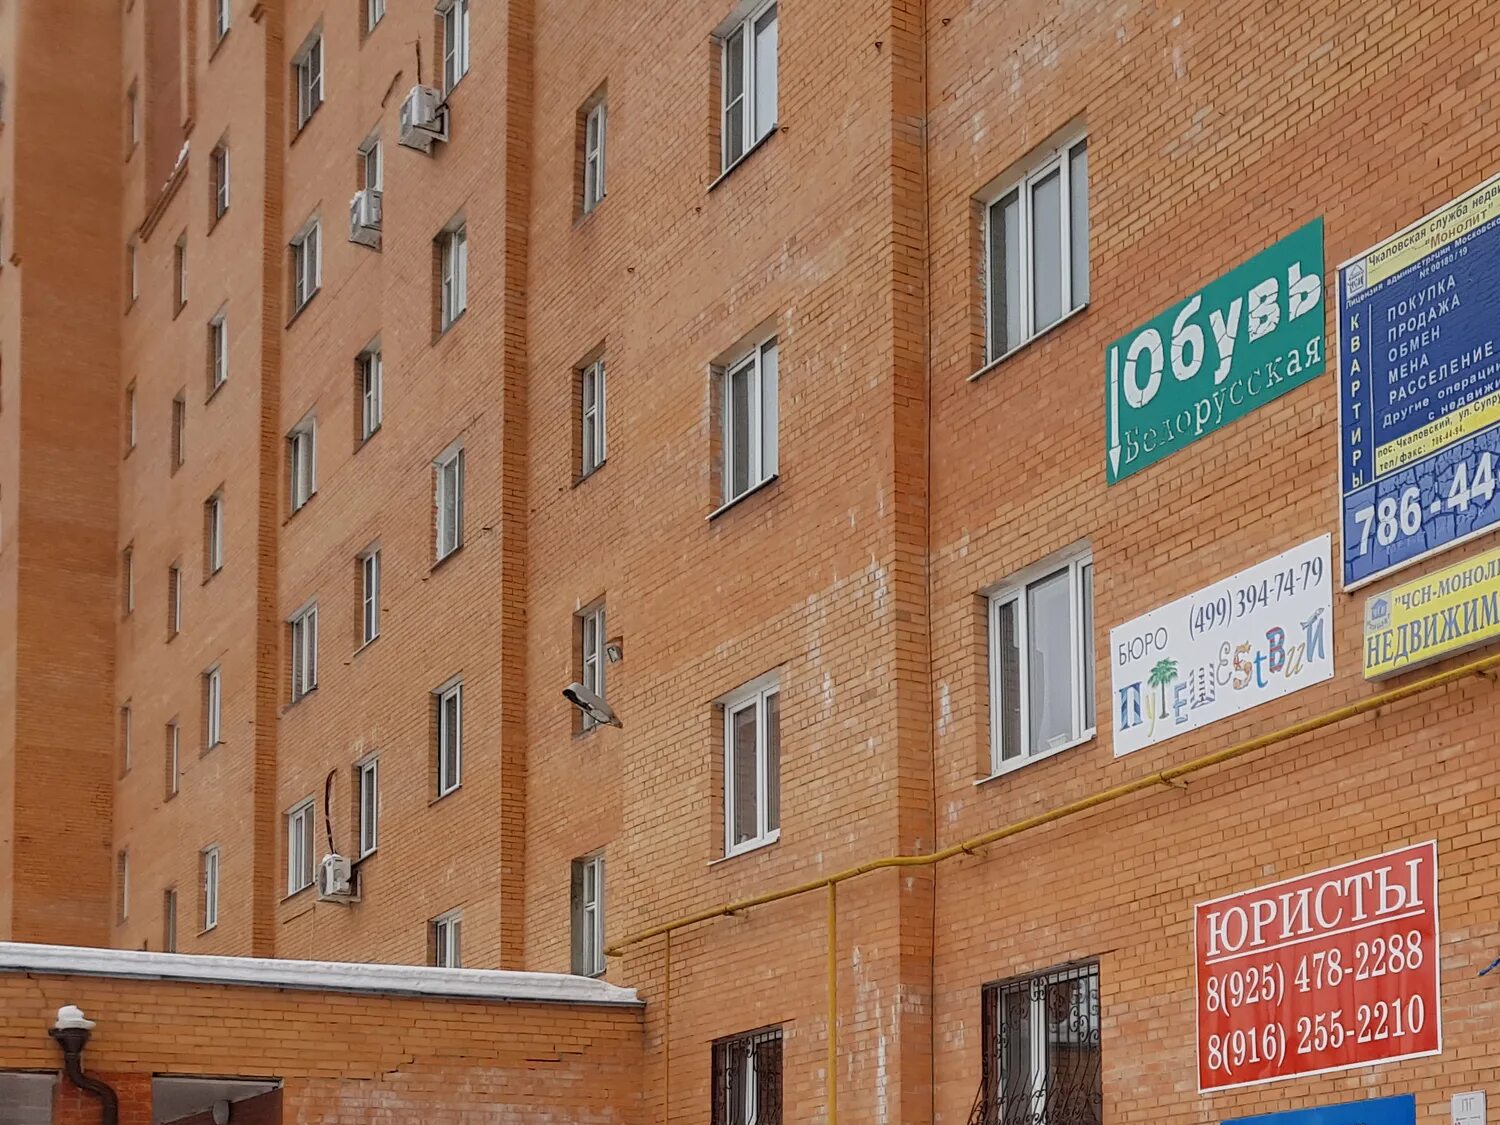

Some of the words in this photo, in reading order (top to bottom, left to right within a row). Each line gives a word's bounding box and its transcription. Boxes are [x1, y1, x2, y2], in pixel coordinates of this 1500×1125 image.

[1368, 228, 1427, 267] Чкаловская
[1429, 206, 1469, 233] служба
[1346, 283, 1384, 310] Лицензия
[1387, 245, 1451, 286] администрации
[1387, 274, 1456, 322] ПОКУПКА
[1122, 261, 1322, 409] Обувь
[1388, 294, 1461, 342] ПРОДАЖА
[1388, 325, 1440, 362] ОБМЕН
[1124, 335, 1321, 464] Белорусская
[1350, 313, 1364, 488] КВАРТИРЫ
[1388, 354, 1430, 384] МЕНА
[1388, 341, 1494, 405] РАССЕЛЕНИЕ
[1377, 445, 1396, 458] пос.
[1458, 408, 1472, 421] ул.
[1383, 398, 1429, 428] Другие
[1428, 411, 1435, 420] с
[1119, 626, 1168, 667] БЮРО
[1189, 589, 1233, 641] (499)
[1236, 556, 1323, 618] 394-74-79
[1206, 858, 1424, 957] ЮРИСТЫ
[1206, 961, 1285, 1017] 8(925)
[1294, 929, 1424, 993] 478-2288
[1207, 1021, 1286, 1076] 8(916)
[1296, 994, 1425, 1054] 255-2210
